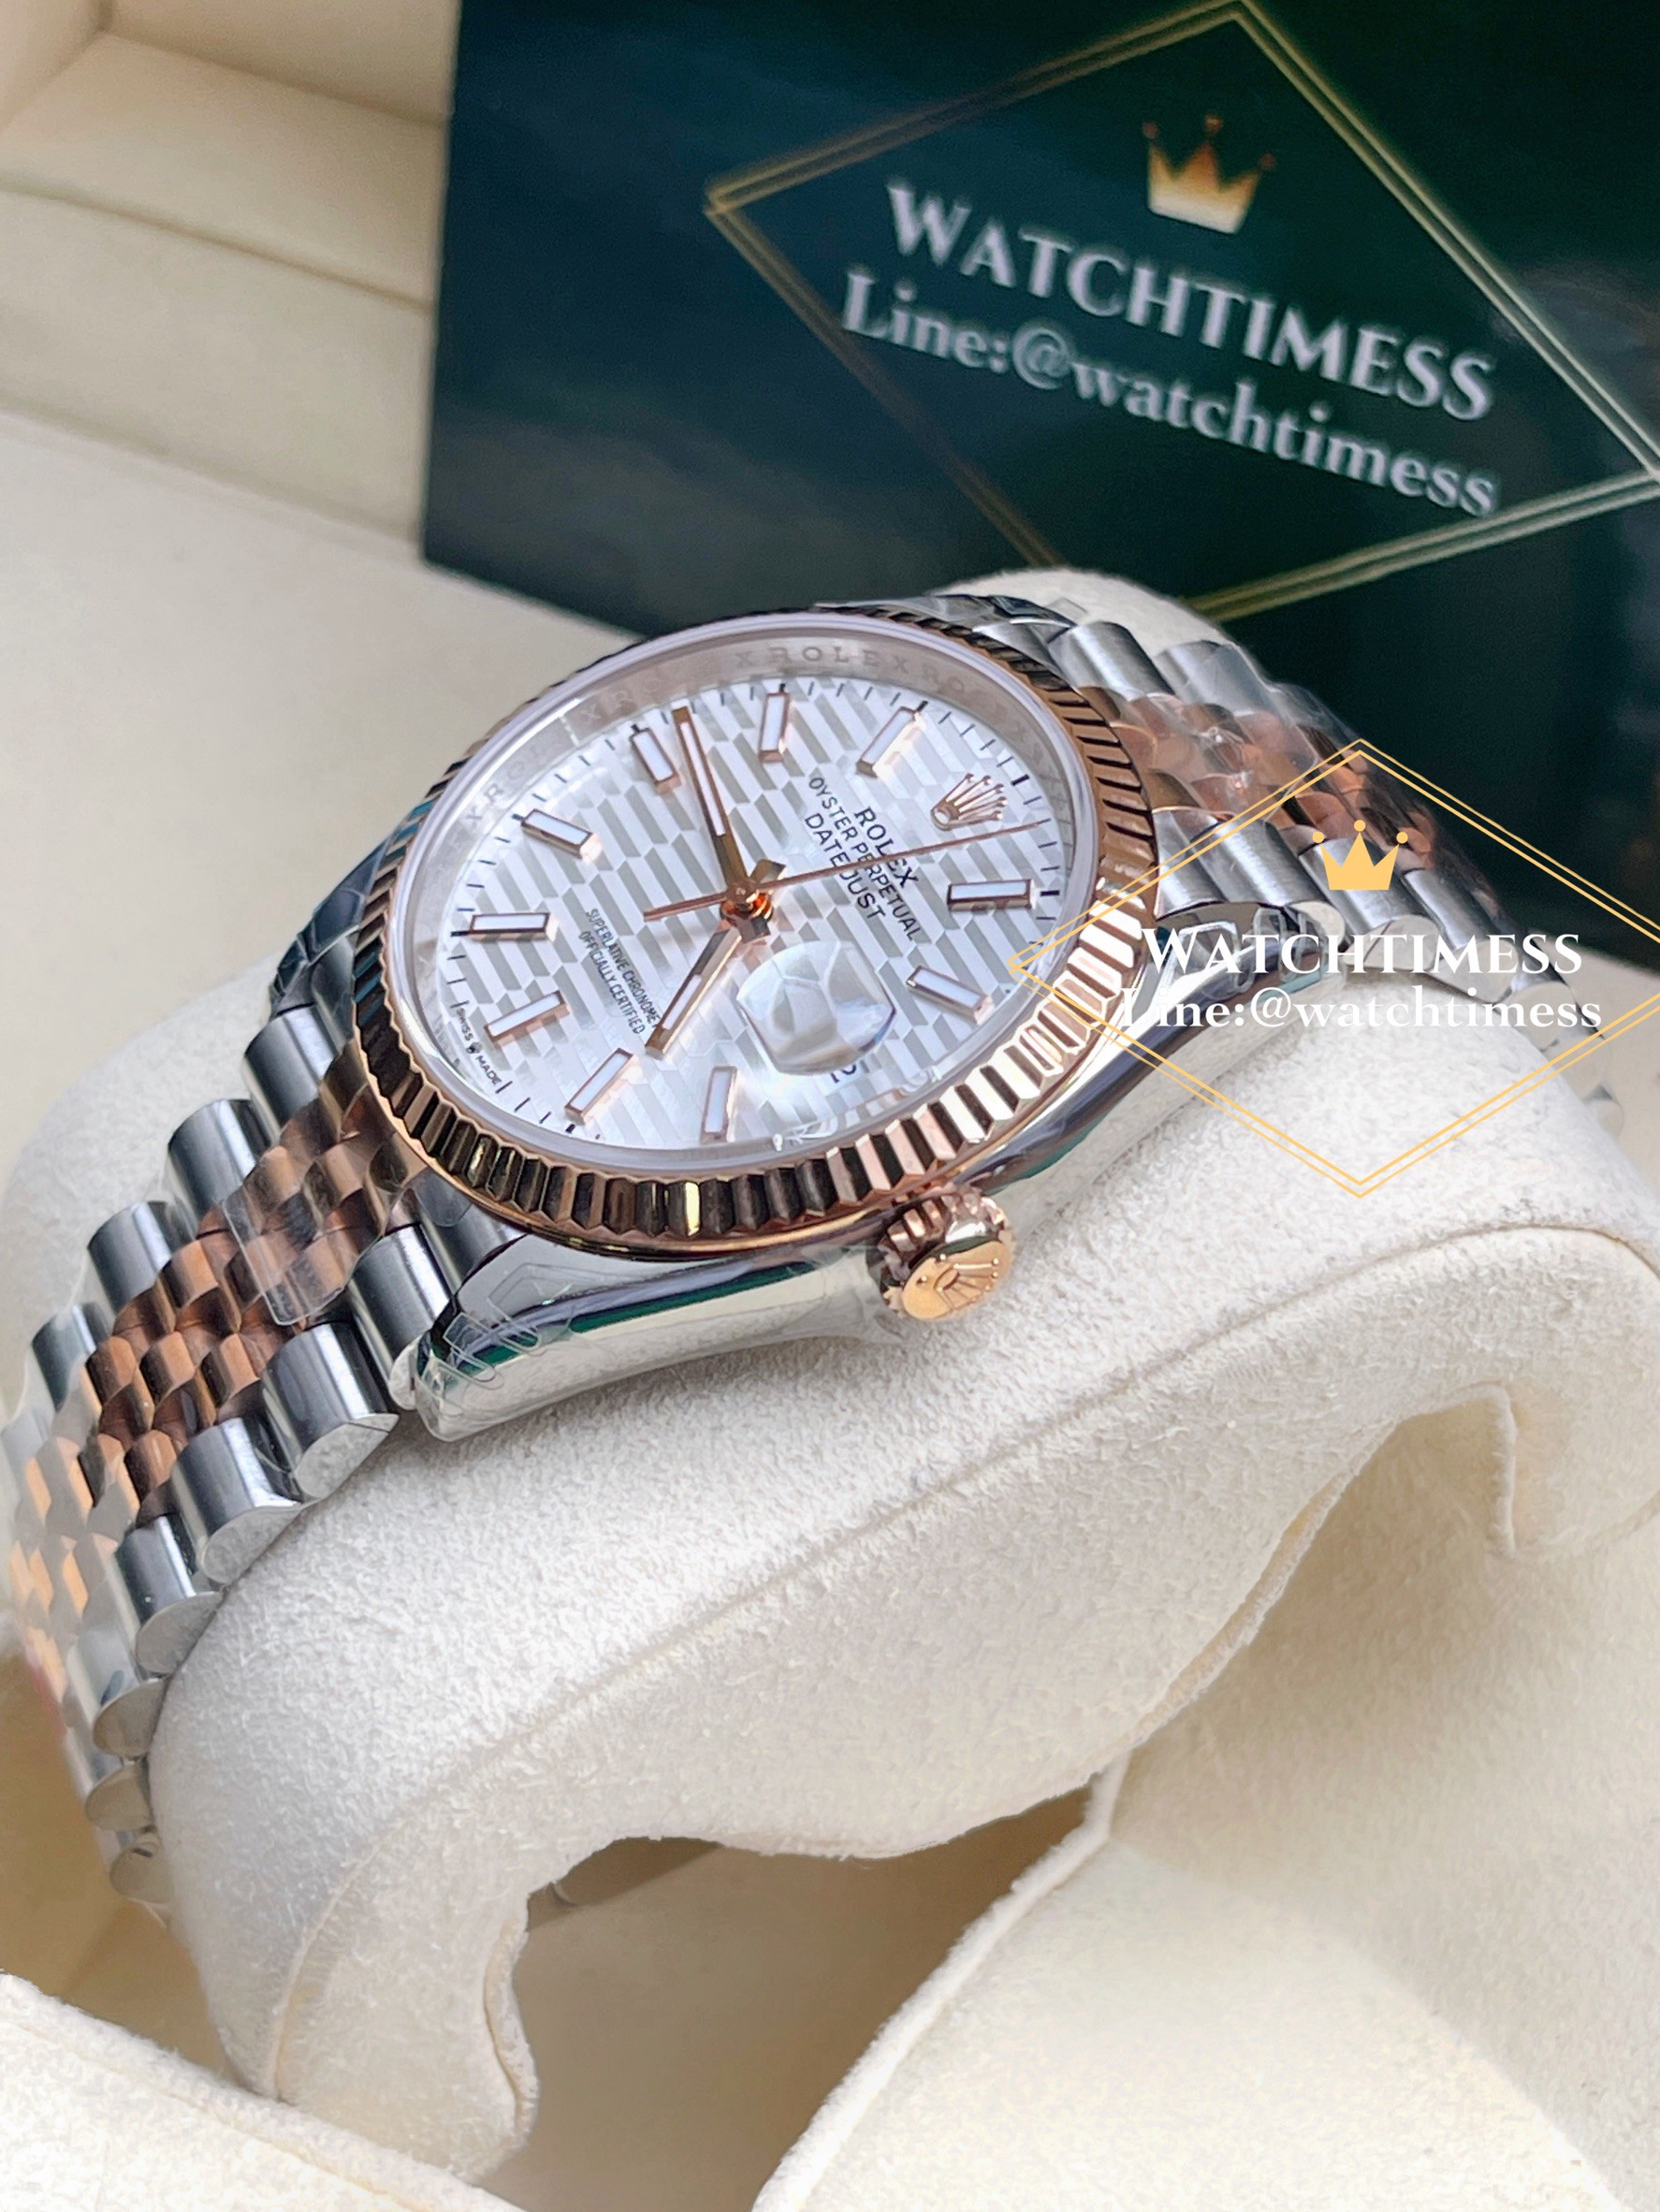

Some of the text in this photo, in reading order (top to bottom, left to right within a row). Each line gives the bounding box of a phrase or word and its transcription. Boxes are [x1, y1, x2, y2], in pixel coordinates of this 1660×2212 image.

[885, 178, 1493, 422] WATCHTIMESS
[840, 266, 1496, 517] Line:@watchtimess
[808, 777, 859, 842] OYSTER
[586, 908, 630, 971] SUPERLATIVE
[609, 983, 646, 1034] CERTIFIED
